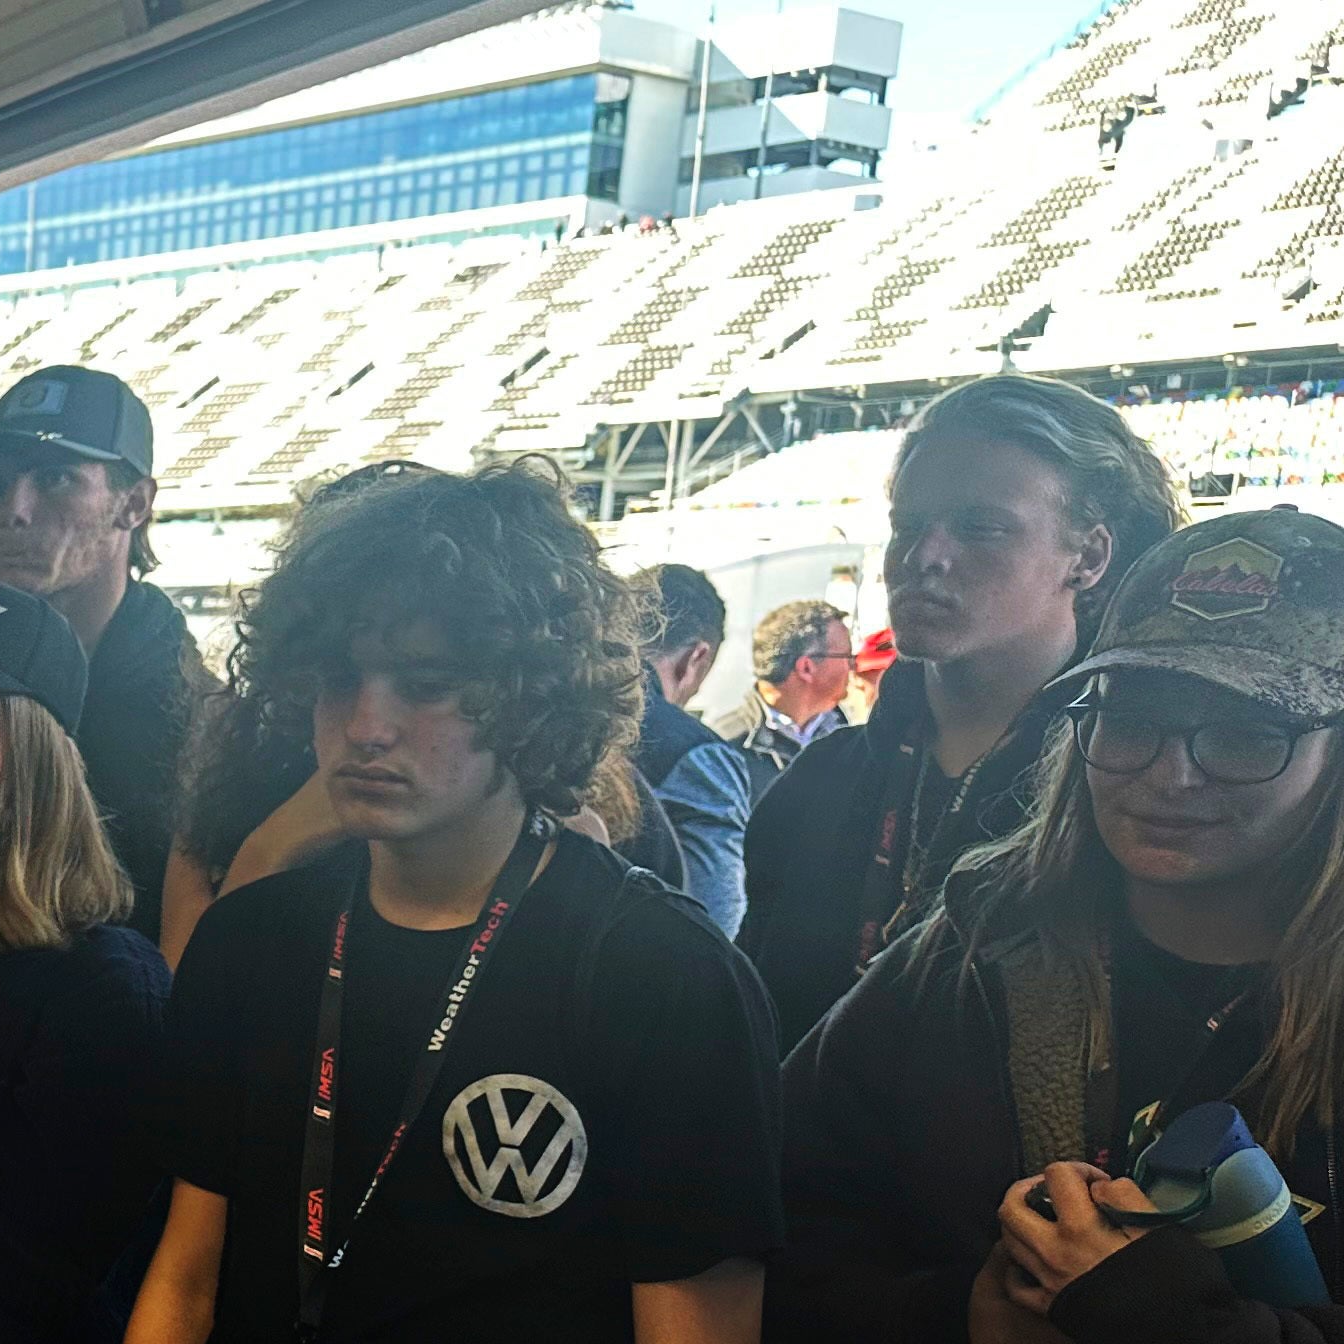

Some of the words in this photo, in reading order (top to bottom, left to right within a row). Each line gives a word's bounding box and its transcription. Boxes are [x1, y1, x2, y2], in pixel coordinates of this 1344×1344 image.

[333, 910, 349, 960] IMSA
[428, 897, 509, 1052] WeatherTech
[317, 1046, 335, 1101] IMSA
[307, 1187, 324, 1241] IMSA
